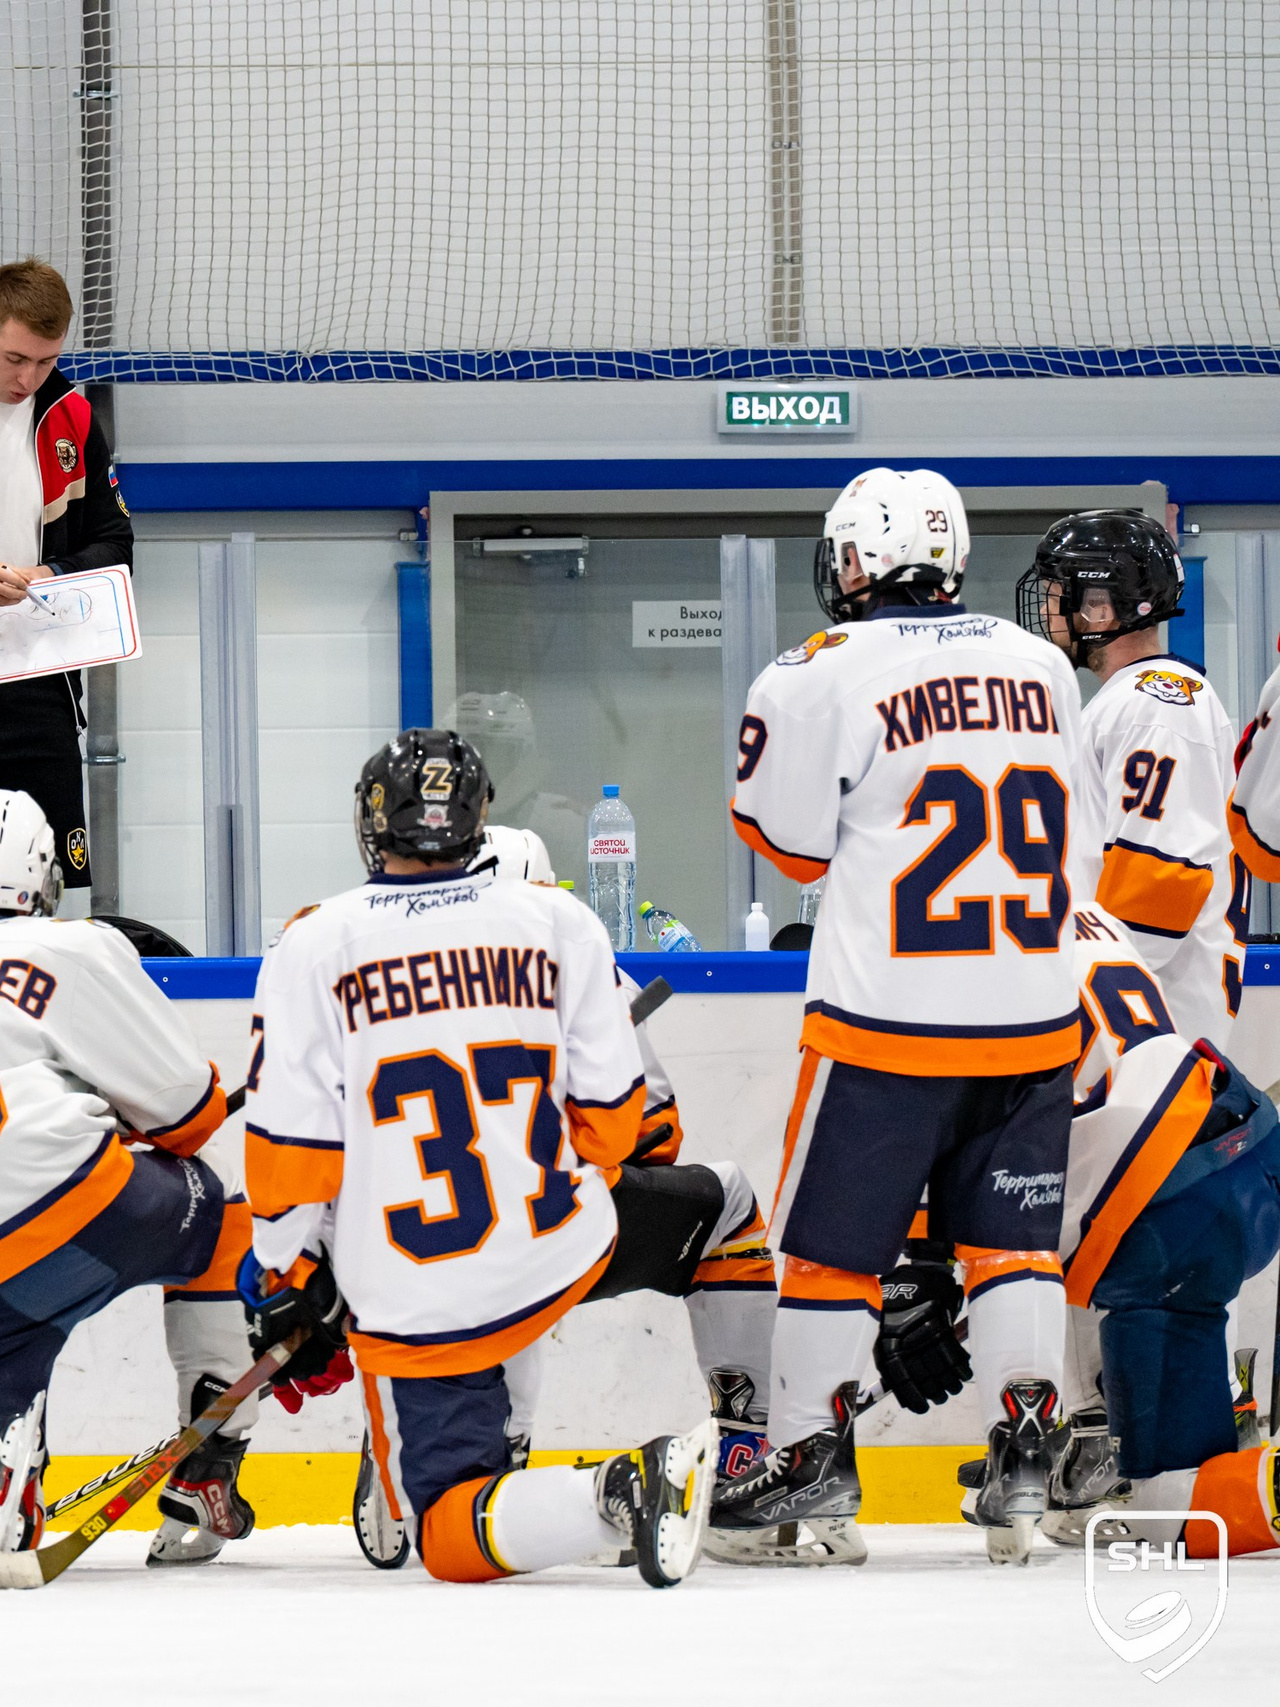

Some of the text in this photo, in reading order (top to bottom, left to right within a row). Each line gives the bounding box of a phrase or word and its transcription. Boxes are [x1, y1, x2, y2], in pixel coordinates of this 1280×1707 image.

[731, 396, 842, 424] ВЫХОД
[835, 521, 856, 532] CCM
[925, 510, 948, 533] 29
[1077, 570, 1111, 579] CCM
[421, 764, 452, 793] Z
[1121, 749, 1177, 822] 91
[590, 847, 630, 855] ИСТОЧНИК
[890, 762, 1071, 958] 29
[367, 1039, 583, 1265] 37
[80, 1516, 108, 1541] 930
